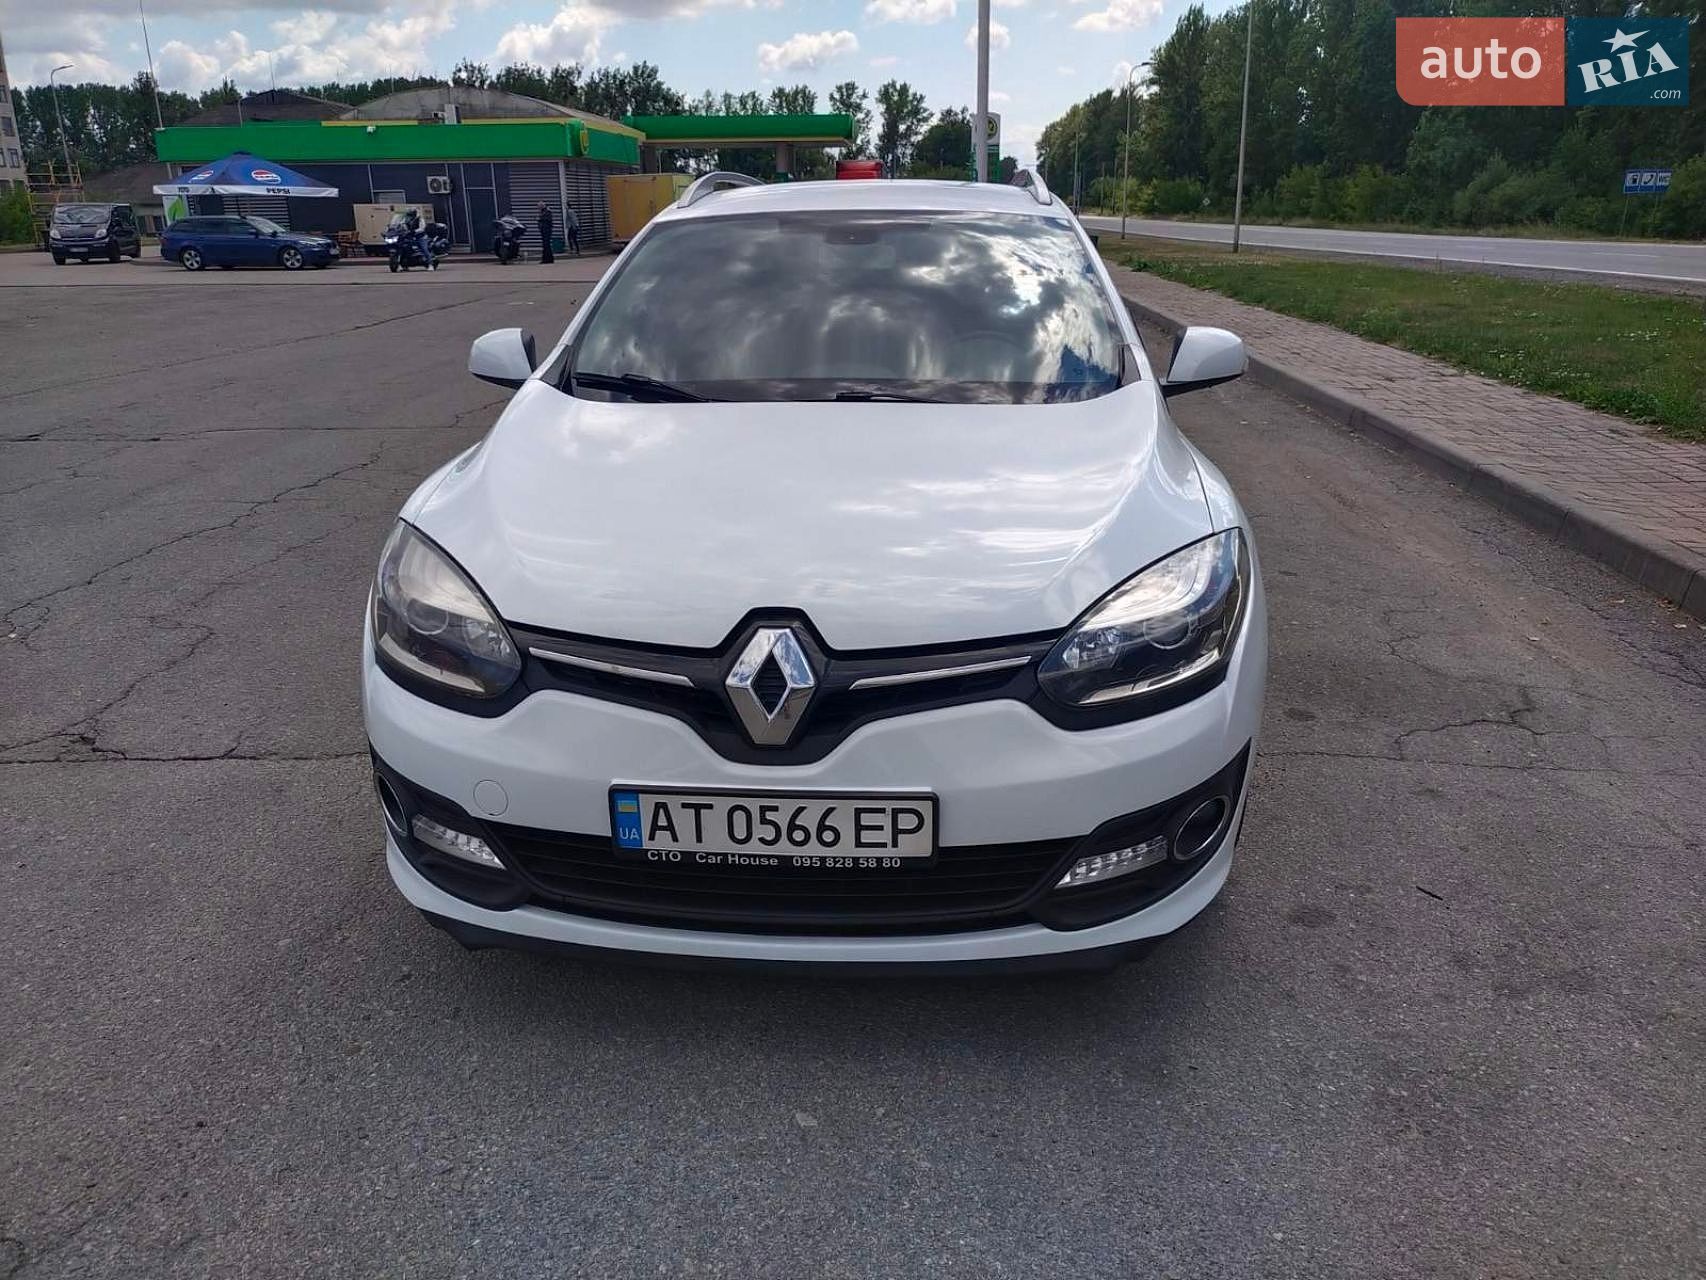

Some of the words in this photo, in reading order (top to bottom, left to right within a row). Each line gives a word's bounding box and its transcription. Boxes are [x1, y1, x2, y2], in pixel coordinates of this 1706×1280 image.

[265, 187, 291, 195] PEPSI
[648, 801, 714, 843] AT
[727, 804, 841, 848] 0566
[854, 807, 925, 848] EP
[619, 827, 641, 840] UA
[696, 852, 723, 864] Car
[728, 854, 779, 866] House
[792, 857, 821, 867] 095
[826, 857, 853, 868] 828
[858, 858, 877, 868] 58
[882, 858, 901, 868] 80
